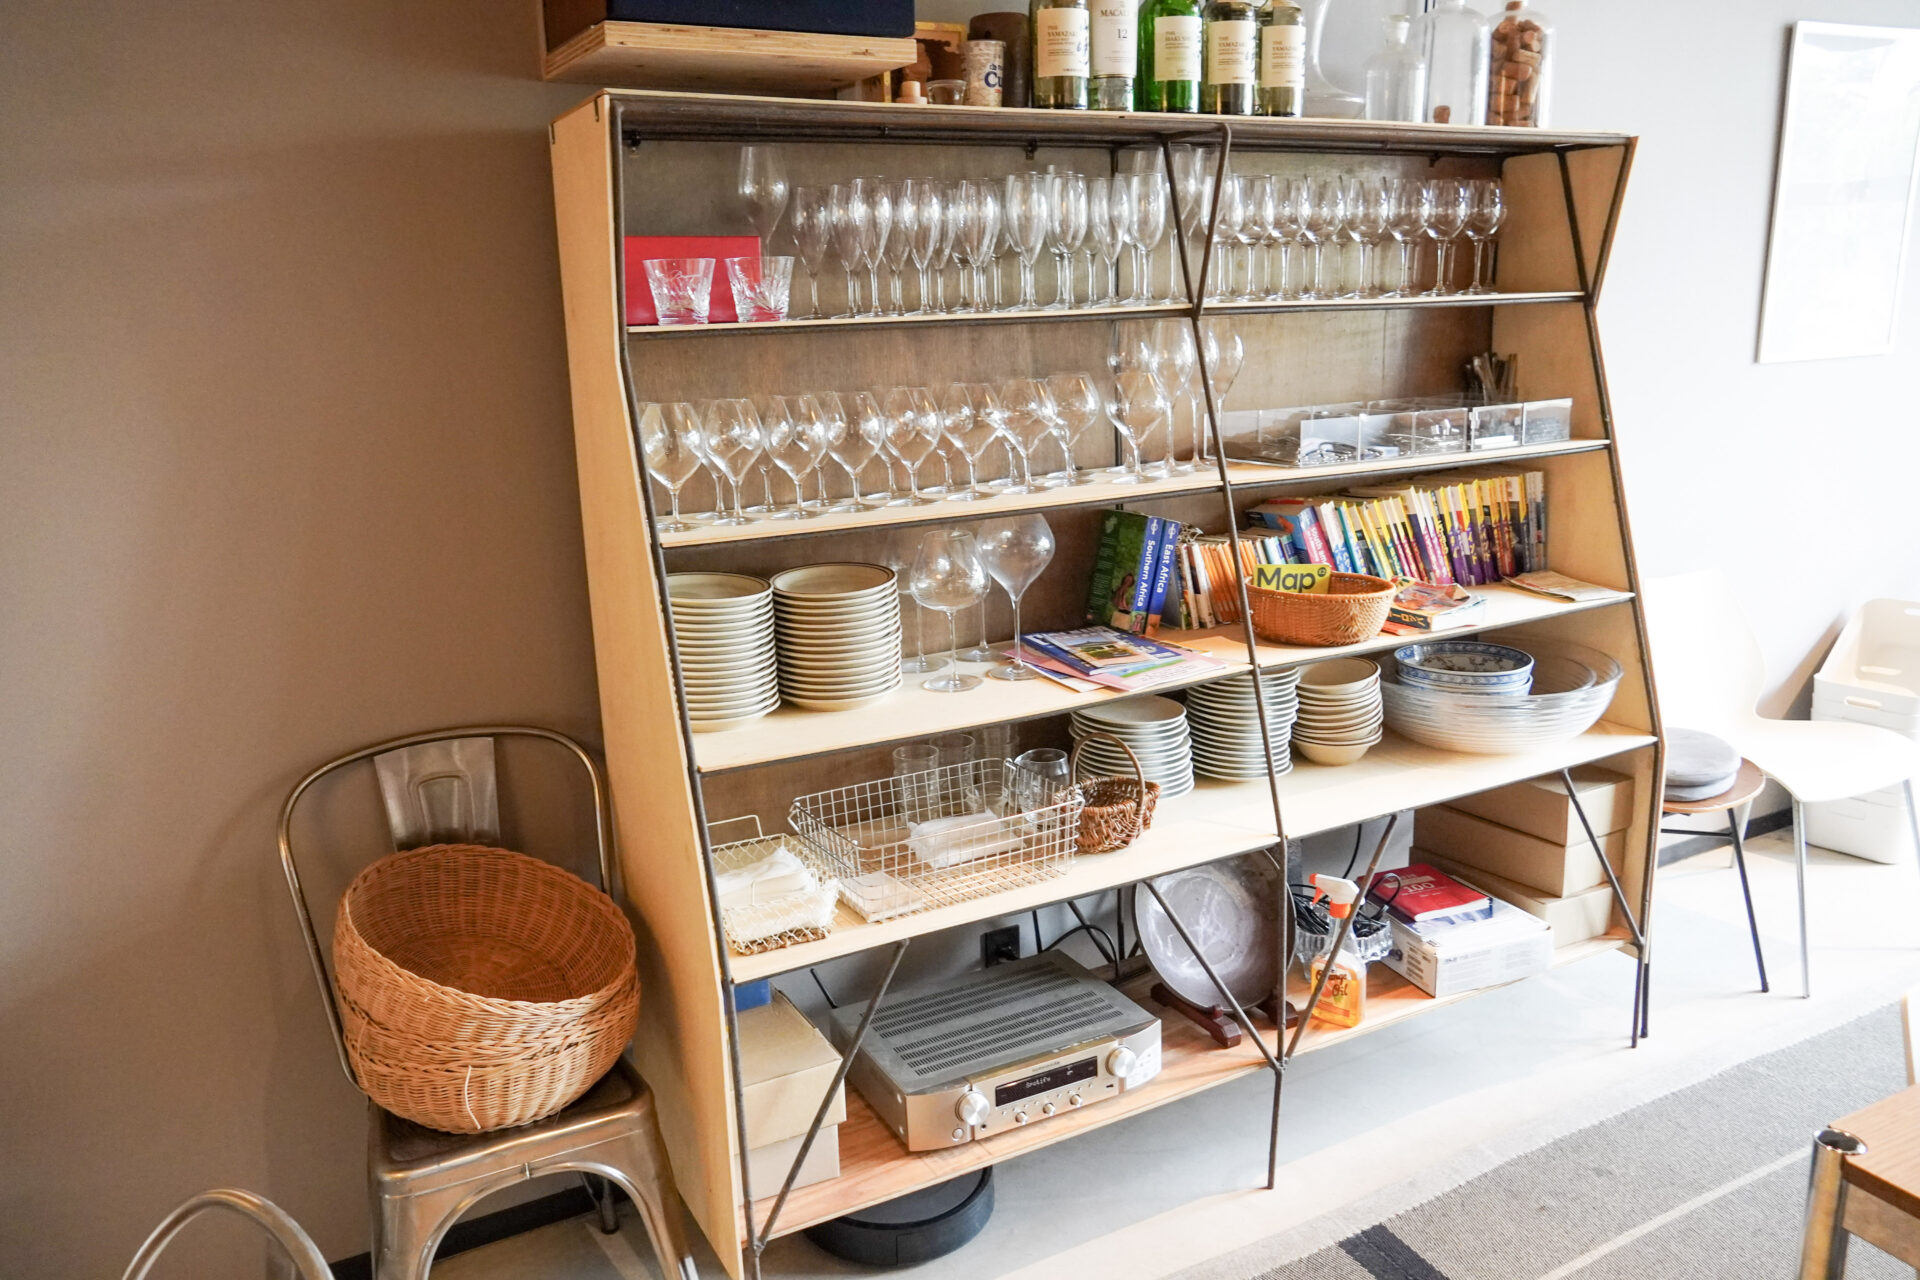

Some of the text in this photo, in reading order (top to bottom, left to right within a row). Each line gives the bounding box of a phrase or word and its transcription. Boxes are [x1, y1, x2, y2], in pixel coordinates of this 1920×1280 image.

[1117, 28, 1128, 39] 12
[1137, 540, 1156, 607] Southern Africa
[1157, 544, 1174, 593] East Africa
[1257, 567, 1316, 593] Map
[1403, 882, 1435, 893] 100
[1315, 969, 1347, 985] Oange
[1332, 983, 1348, 997] Oil
[1025, 1076, 1051, 1089] Spotify
